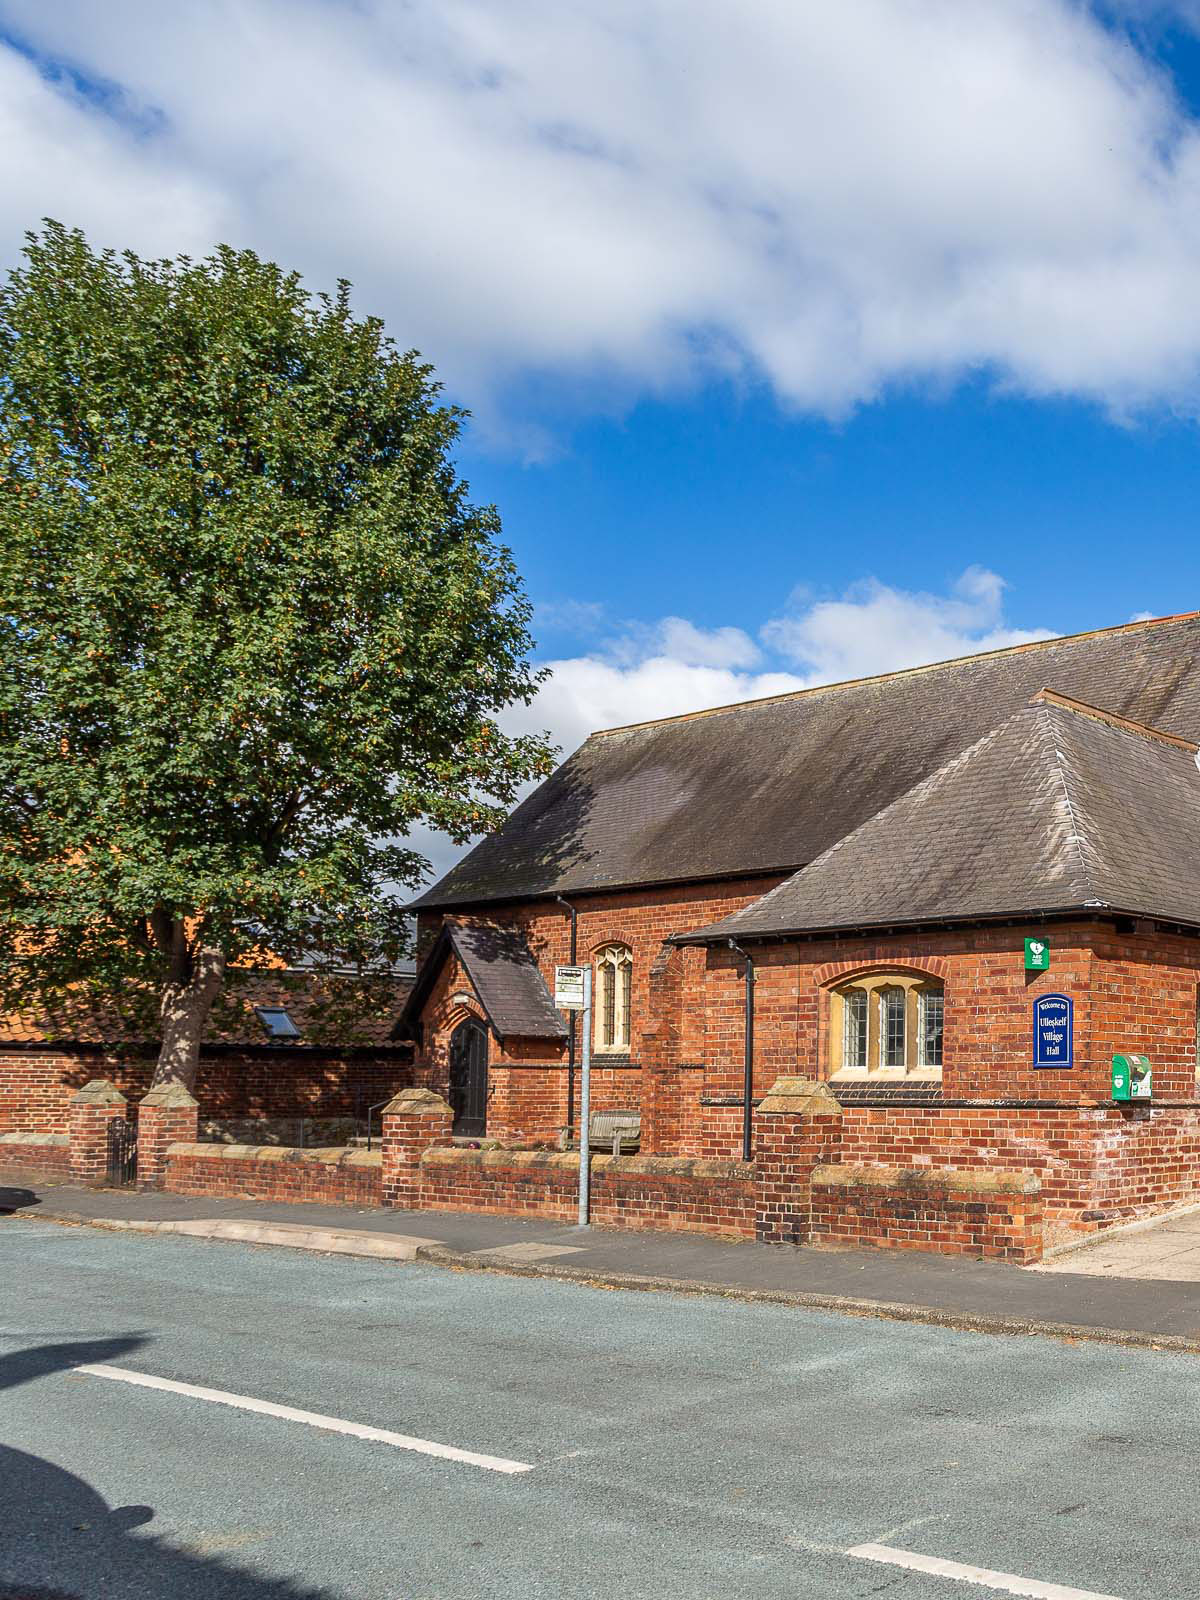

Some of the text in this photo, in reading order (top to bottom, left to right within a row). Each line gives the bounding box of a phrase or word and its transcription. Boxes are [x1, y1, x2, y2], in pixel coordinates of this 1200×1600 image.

[1040, 1002, 1060, 1010] Welcome
[1040, 1016, 1067, 1027] Ulleskelf
[1043, 1032, 1064, 1043] Village
[1046, 1046, 1060, 1056] Hall
